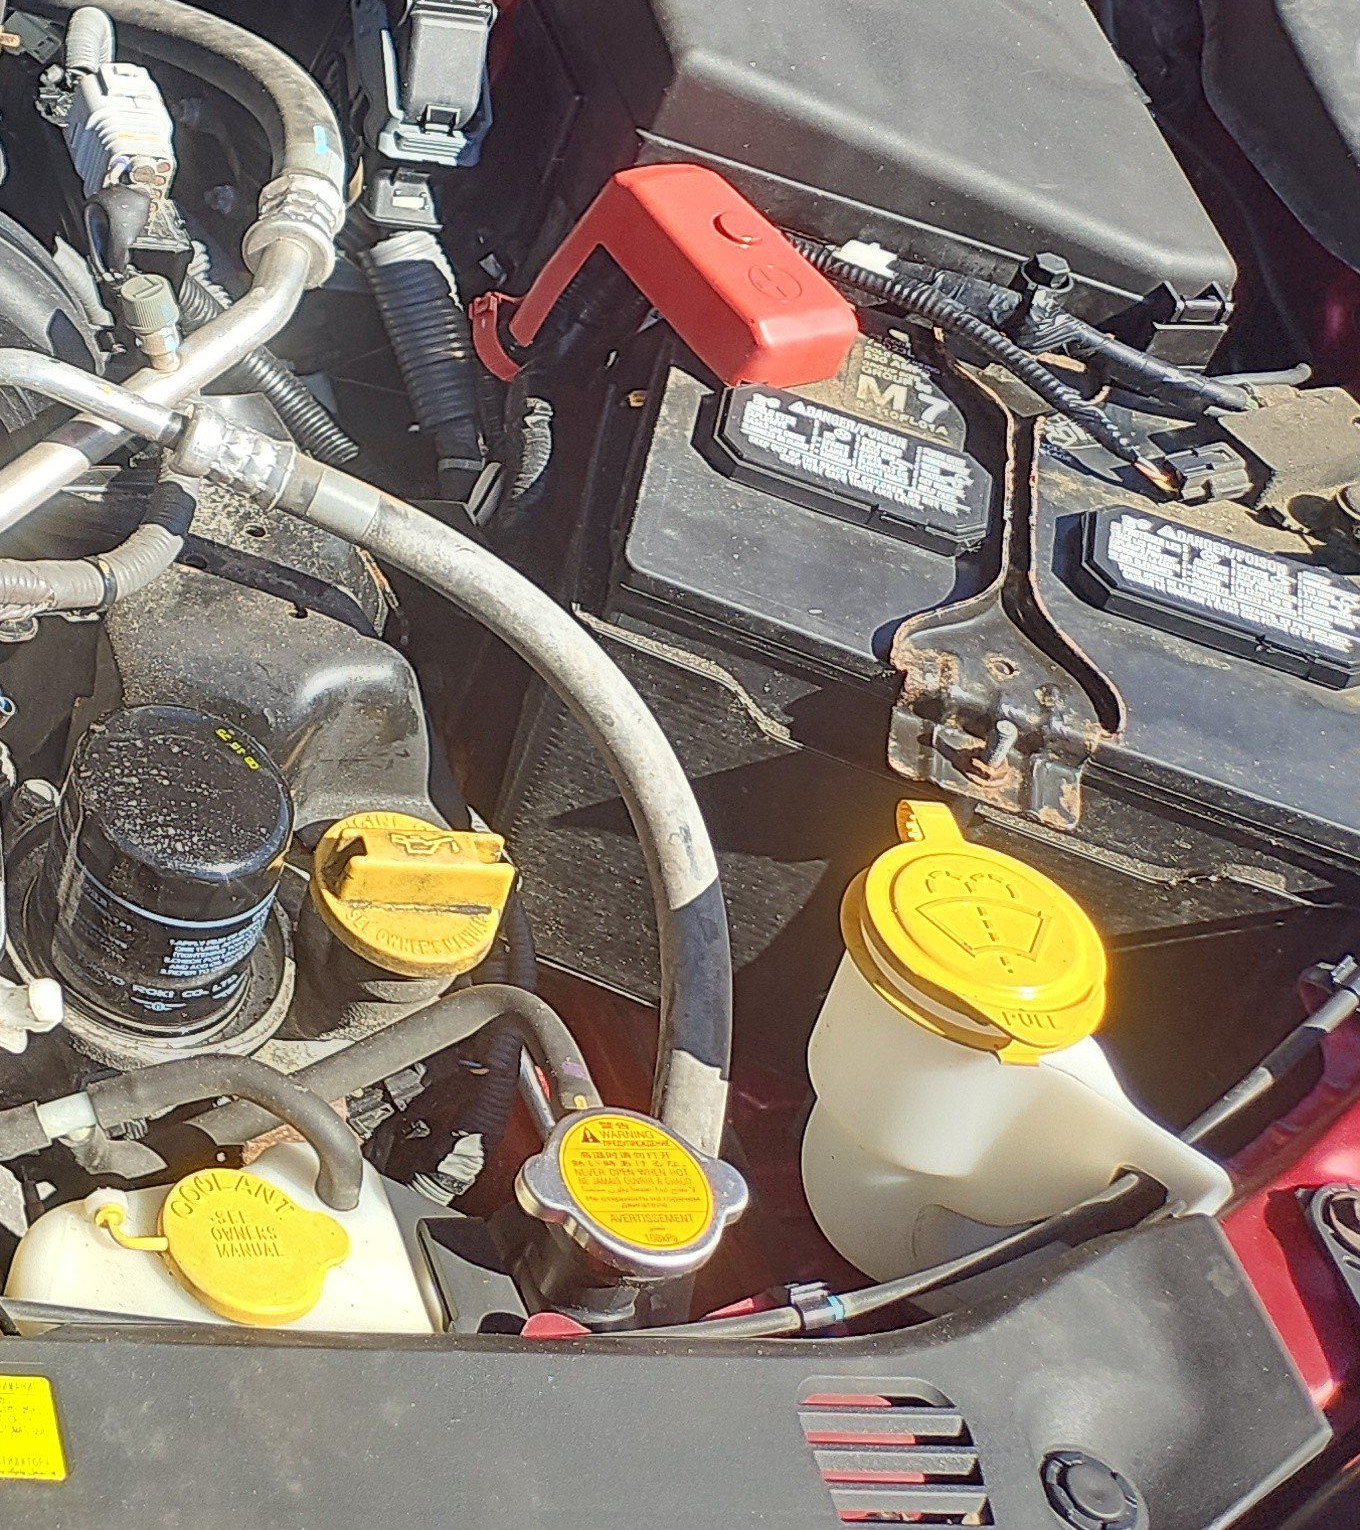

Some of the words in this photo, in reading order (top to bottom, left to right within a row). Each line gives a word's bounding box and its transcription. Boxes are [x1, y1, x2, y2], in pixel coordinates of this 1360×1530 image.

[856, 373, 908, 412] M
[917, 392, 950, 423] 7
[132, 984, 175, 1000] ROKI
[599, 1130, 655, 1140] WARNING
[170, 1172, 295, 1220] COOLANT
[610, 1213, 695, 1224] AVERTISSEMENT
[215, 1241, 285, 1259] MANUAL
